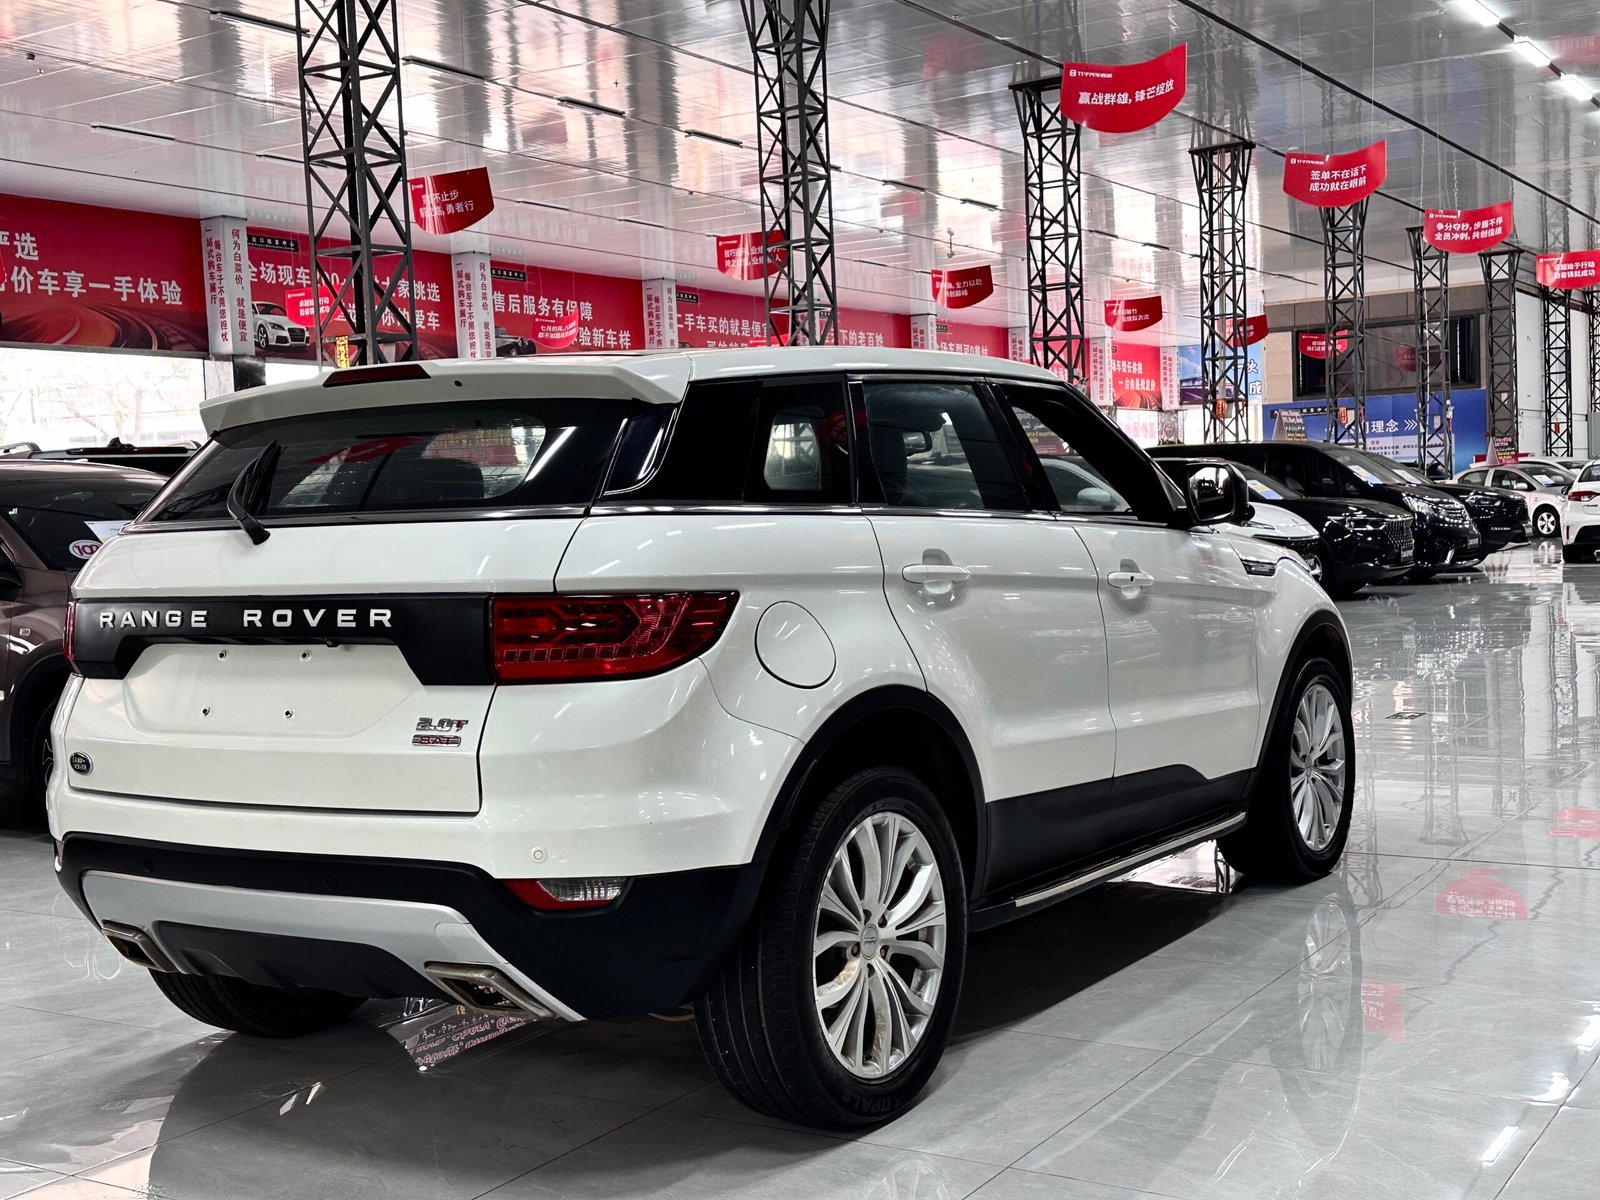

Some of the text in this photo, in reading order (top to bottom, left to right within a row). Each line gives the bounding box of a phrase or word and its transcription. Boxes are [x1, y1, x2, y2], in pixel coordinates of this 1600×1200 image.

[1310, 164, 1367, 180] 签单不在话下
[1309, 176, 1367, 192] 成功就在眼前
[0, 265, 183, 305] 价车享一手体验
[571, 326, 632, 349] 验新车样
[100, 608, 392, 628] RANGE ROVER
[415, 717, 469, 732] 2.0T
